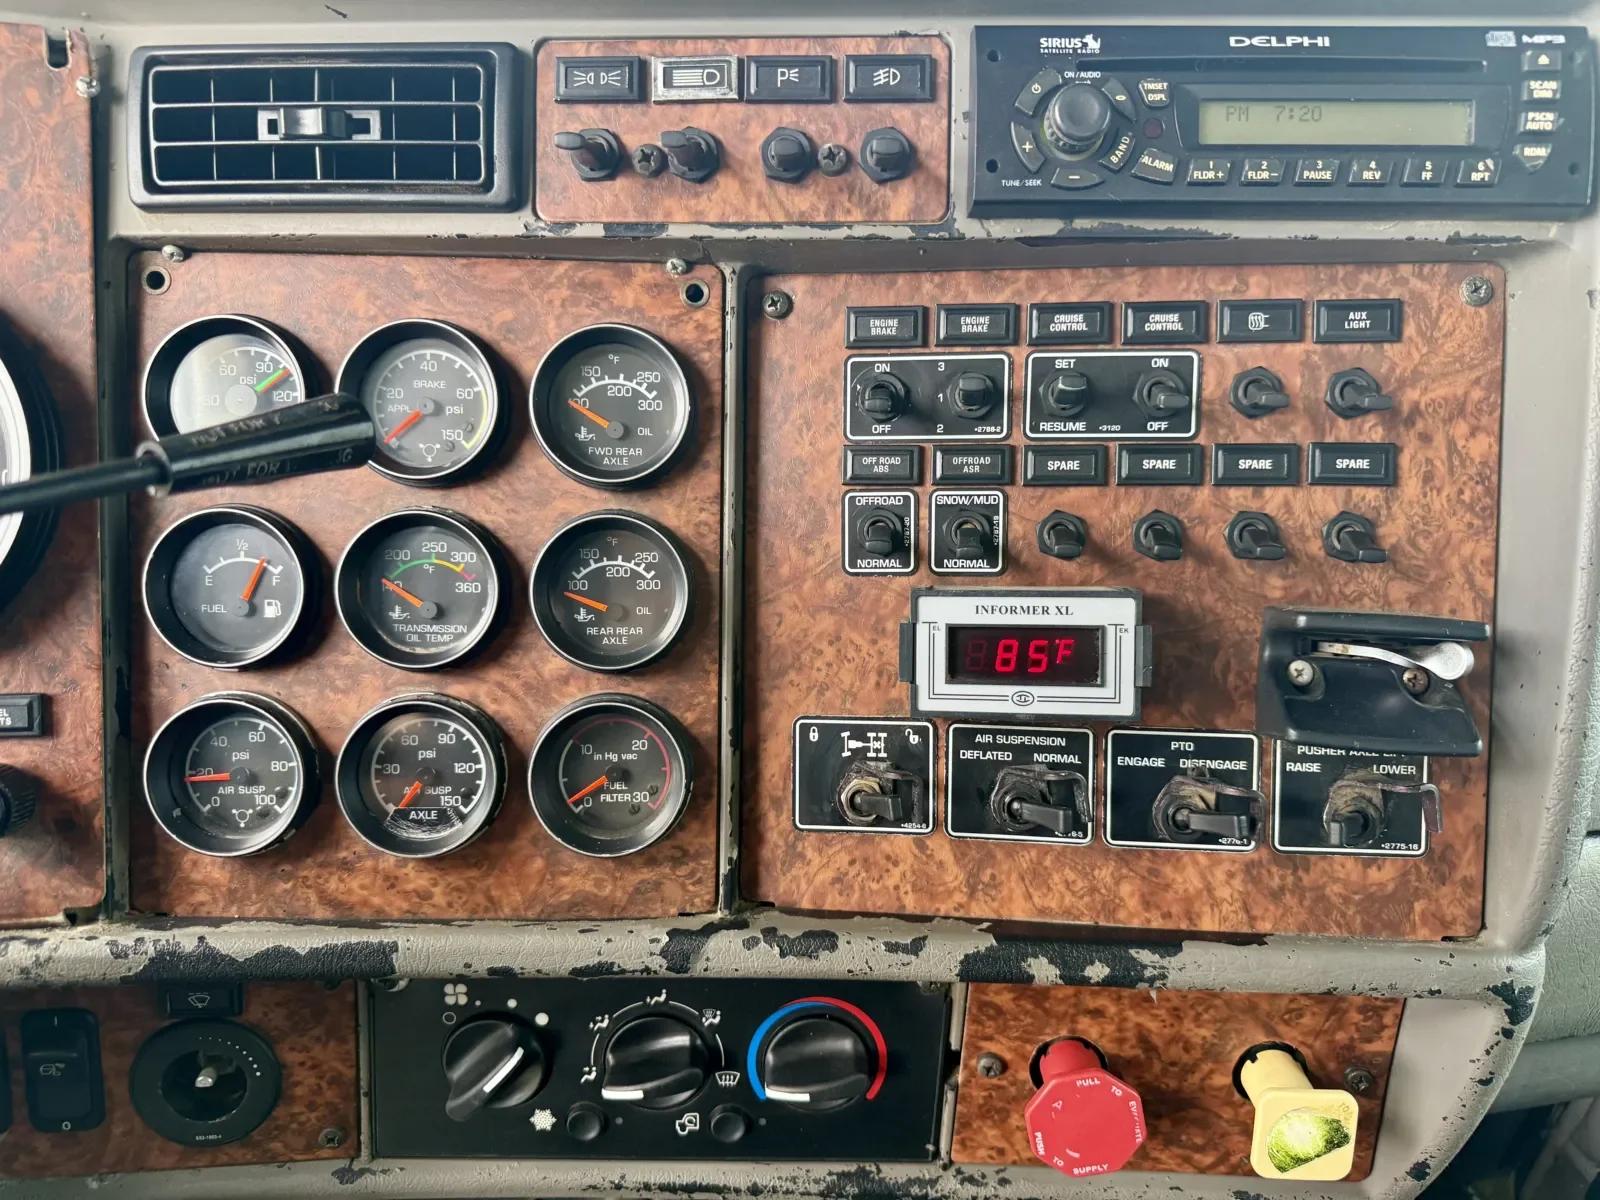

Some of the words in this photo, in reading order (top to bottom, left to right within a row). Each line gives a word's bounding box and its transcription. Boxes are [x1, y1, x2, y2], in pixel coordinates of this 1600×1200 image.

[1040, 37, 1083, 48] SIRIUS
[1229, 36, 1330, 47] DELPHI
[1529, 80, 1558, 90] SCAN
[1225, 105, 1249, 122] PM
[1274, 105, 1322, 122] 7:20
[1525, 121, 1553, 131] AUTO
[1110, 136, 1131, 164] BAND
[1142, 154, 1175, 173] ALARM
[1208, 161, 1214, 170] 1
[1260, 161, 1269, 170] 2
[1315, 161, 1324, 170] 3
[1368, 161, 1377, 170] 4
[1424, 161, 1433, 171] 5
[1476, 161, 1486, 171] 6
[1303, 170, 1333, 180] PAUSE
[1362, 171, 1382, 181] REV
[1421, 171, 1433, 181] FF
[1470, 172, 1491, 182] RPT
[961, 316, 990, 325] ENGINE
[1054, 314, 1084, 323] CRUISE
[1149, 313, 1179, 322] CRUISE
[1348, 311, 1368, 321] AUX
[869, 319, 899, 328] ENGINE
[961, 324, 989, 333] BRAKE
[1050, 322, 1088, 332] CONTROL
[1144, 322, 1184, 332] CONTROL
[1344, 320, 1371, 329] LIGHT
[870, 327, 897, 336] BRAKE
[255, 361, 274, 373] 90
[420, 360, 437, 372] 40
[874, 363, 890, 373] ON
[937, 362, 945, 371] 3
[1055, 359, 1076, 369] SET
[1151, 358, 1168, 368] ON
[581, 366, 601, 377] 150
[636, 371, 661, 383] 250
[413, 380, 447, 389] BRAKE
[272, 390, 293, 402] 120
[387, 388, 404, 399] 20
[456, 388, 474, 400] 60
[607, 385, 632, 397] 200
[937, 393, 944, 402] 1
[638, 399, 662, 411] 300
[446, 405, 464, 417] psi
[637, 427, 653, 436] OIL
[872, 425, 892, 434] OFF
[936, 424, 944, 433] 2
[1040, 422, 1086, 432] RESUME
[1147, 421, 1168, 431] OFF
[441, 429, 463, 441] 150
[588, 447, 613, 456] FWD
[615, 447, 643, 456] REAR
[602, 457, 629, 466] AXLE
[862, 457, 877, 465] OFF
[879, 457, 901, 465] ROAD
[952, 456, 991, 465] OFFROAD
[1047, 460, 1081, 471] SPARE
[1142, 459, 1177, 470] SPARE
[1238, 459, 1273, 470] SPARE
[1335, 459, 1370, 470] SPARE
[873, 465, 889, 474] ABS
[963, 465, 980, 474] ASR
[855, 496, 903, 506] OFFROAD
[936, 495, 999, 506] SNOW/MUD
[421, 541, 447, 553] 250
[384, 549, 411, 561] 200
[450, 551, 476, 563] 300
[580, 548, 600, 559] 150
[634, 552, 659, 563] 250
[857, 559, 903, 569] NORMAL
[943, 559, 990, 569] NORMAL
[606, 566, 630, 577] 200
[205, 575, 213, 586] E
[272, 575, 280, 586] F
[568, 580, 588, 591] 100
[636, 579, 661, 590] 300
[455, 582, 481, 593] 360
[201, 604, 228, 613] FUEL
[636, 606, 652, 615] OIL
[975, 605, 1051, 616] INFORMER
[1054, 605, 1074, 616] XL
[392, 624, 468, 633] TRANSMISSION
[586, 627, 613, 636] REAR
[616, 627, 643, 636] REAR
[406, 633, 422, 642] OIL
[426, 634, 454, 642] TEMP
[601, 637, 628, 645] AXLE
[210, 736, 228, 747] 40
[248, 731, 266, 743] 60
[401, 734, 419, 746] 60
[437, 733, 456, 744] 90
[975, 734, 993, 744] AIR
[996, 735, 1066, 747] SUSPENSION
[581, 744, 593, 755] 10
[631, 739, 649, 751] 20
[1170, 741, 1194, 752] PTO
[232, 749, 250, 762] psi
[418, 747, 436, 760] psi
[593, 752, 602, 760] in
[604, 752, 618, 762] Hg
[959, 750, 1013, 761] DEFLATED
[1033, 753, 1082, 764] NORMAL
[271, 760, 289, 771] 80
[383, 763, 400, 775] 30
[453, 762, 475, 774] 120
[1117, 757, 1166, 767] ENGAGE
[1179, 758, 1248, 770] DISENGAGE
[1285, 762, 1321, 773] RAISE
[1373, 764, 1416, 775] LOWER
[217, 786, 235, 795] AIR
[238, 785, 266, 794] SUSP
[424, 786, 452, 795] SUSP
[603, 781, 628, 790] FUEL
[211, 796, 220, 807] 0
[255, 794, 276, 805] 100
[440, 796, 462, 807] 150
[600, 793, 631, 802] FILTER
[632, 791, 649, 802] 30
[583, 797, 592, 808] 0
[409, 810, 438, 820] AXLE
[1110, 1085, 1123, 1097] TO
[1072, 1163, 1109, 1175] SUPPLY
